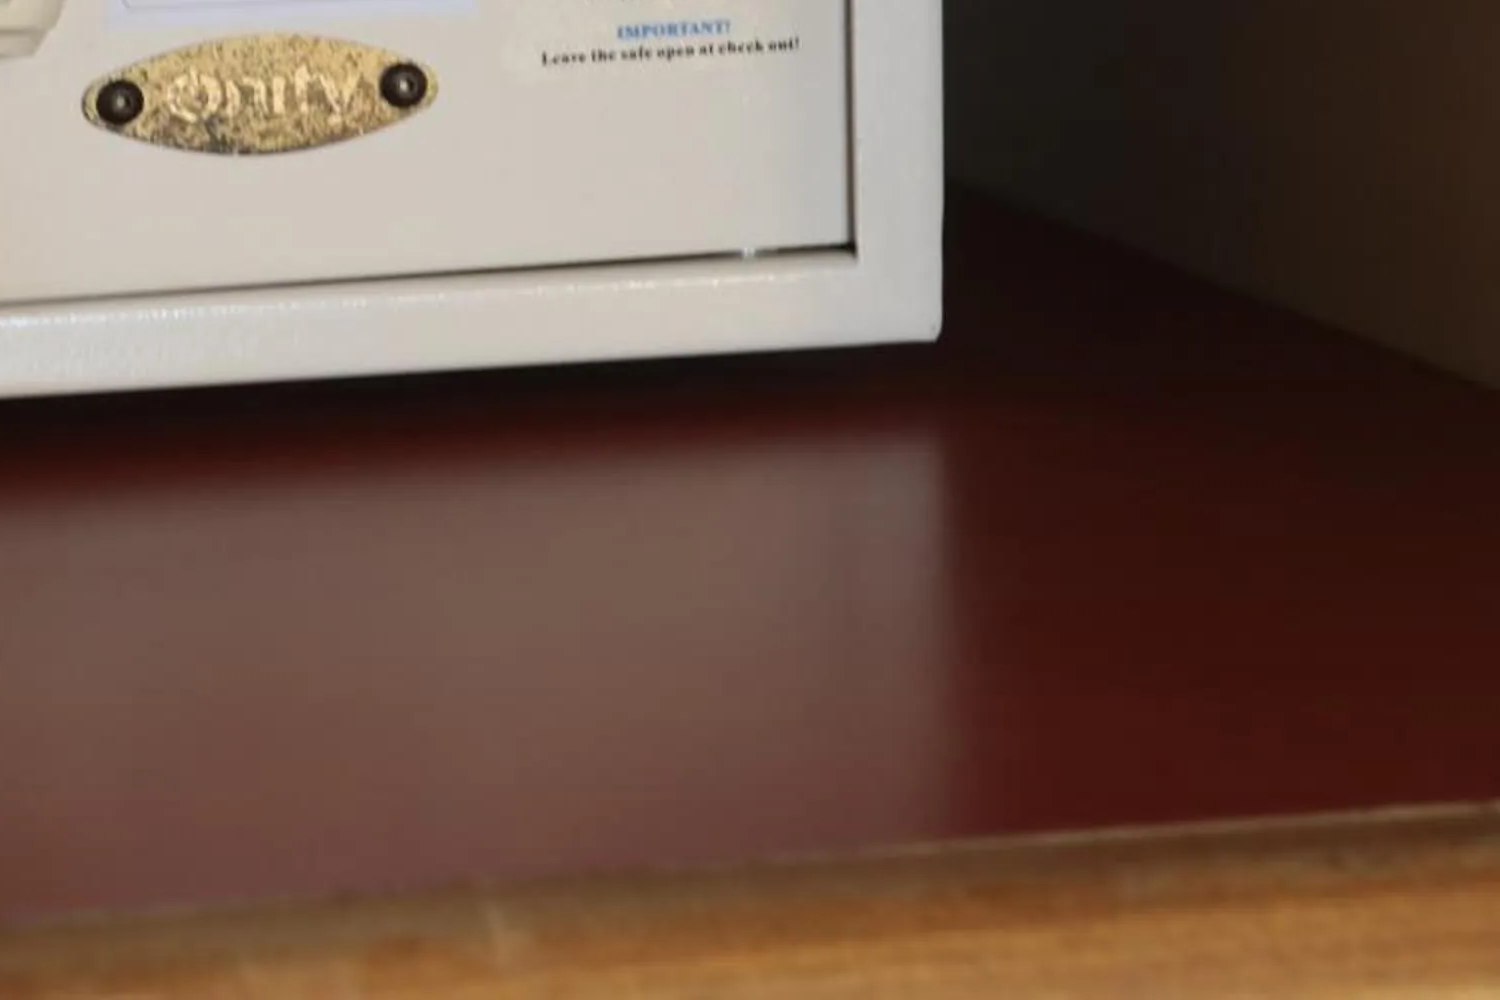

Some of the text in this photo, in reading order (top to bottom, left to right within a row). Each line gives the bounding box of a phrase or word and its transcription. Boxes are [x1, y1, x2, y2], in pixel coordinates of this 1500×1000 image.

[616, 19, 731, 40] IMPORTANT!
[542, 50, 586, 67] Leave
[591, 48, 616, 63] the
[620, 45, 650, 61] safe
[656, 45, 695, 62] open
[699, 42, 714, 56] at
[718, 39, 764, 55] check
